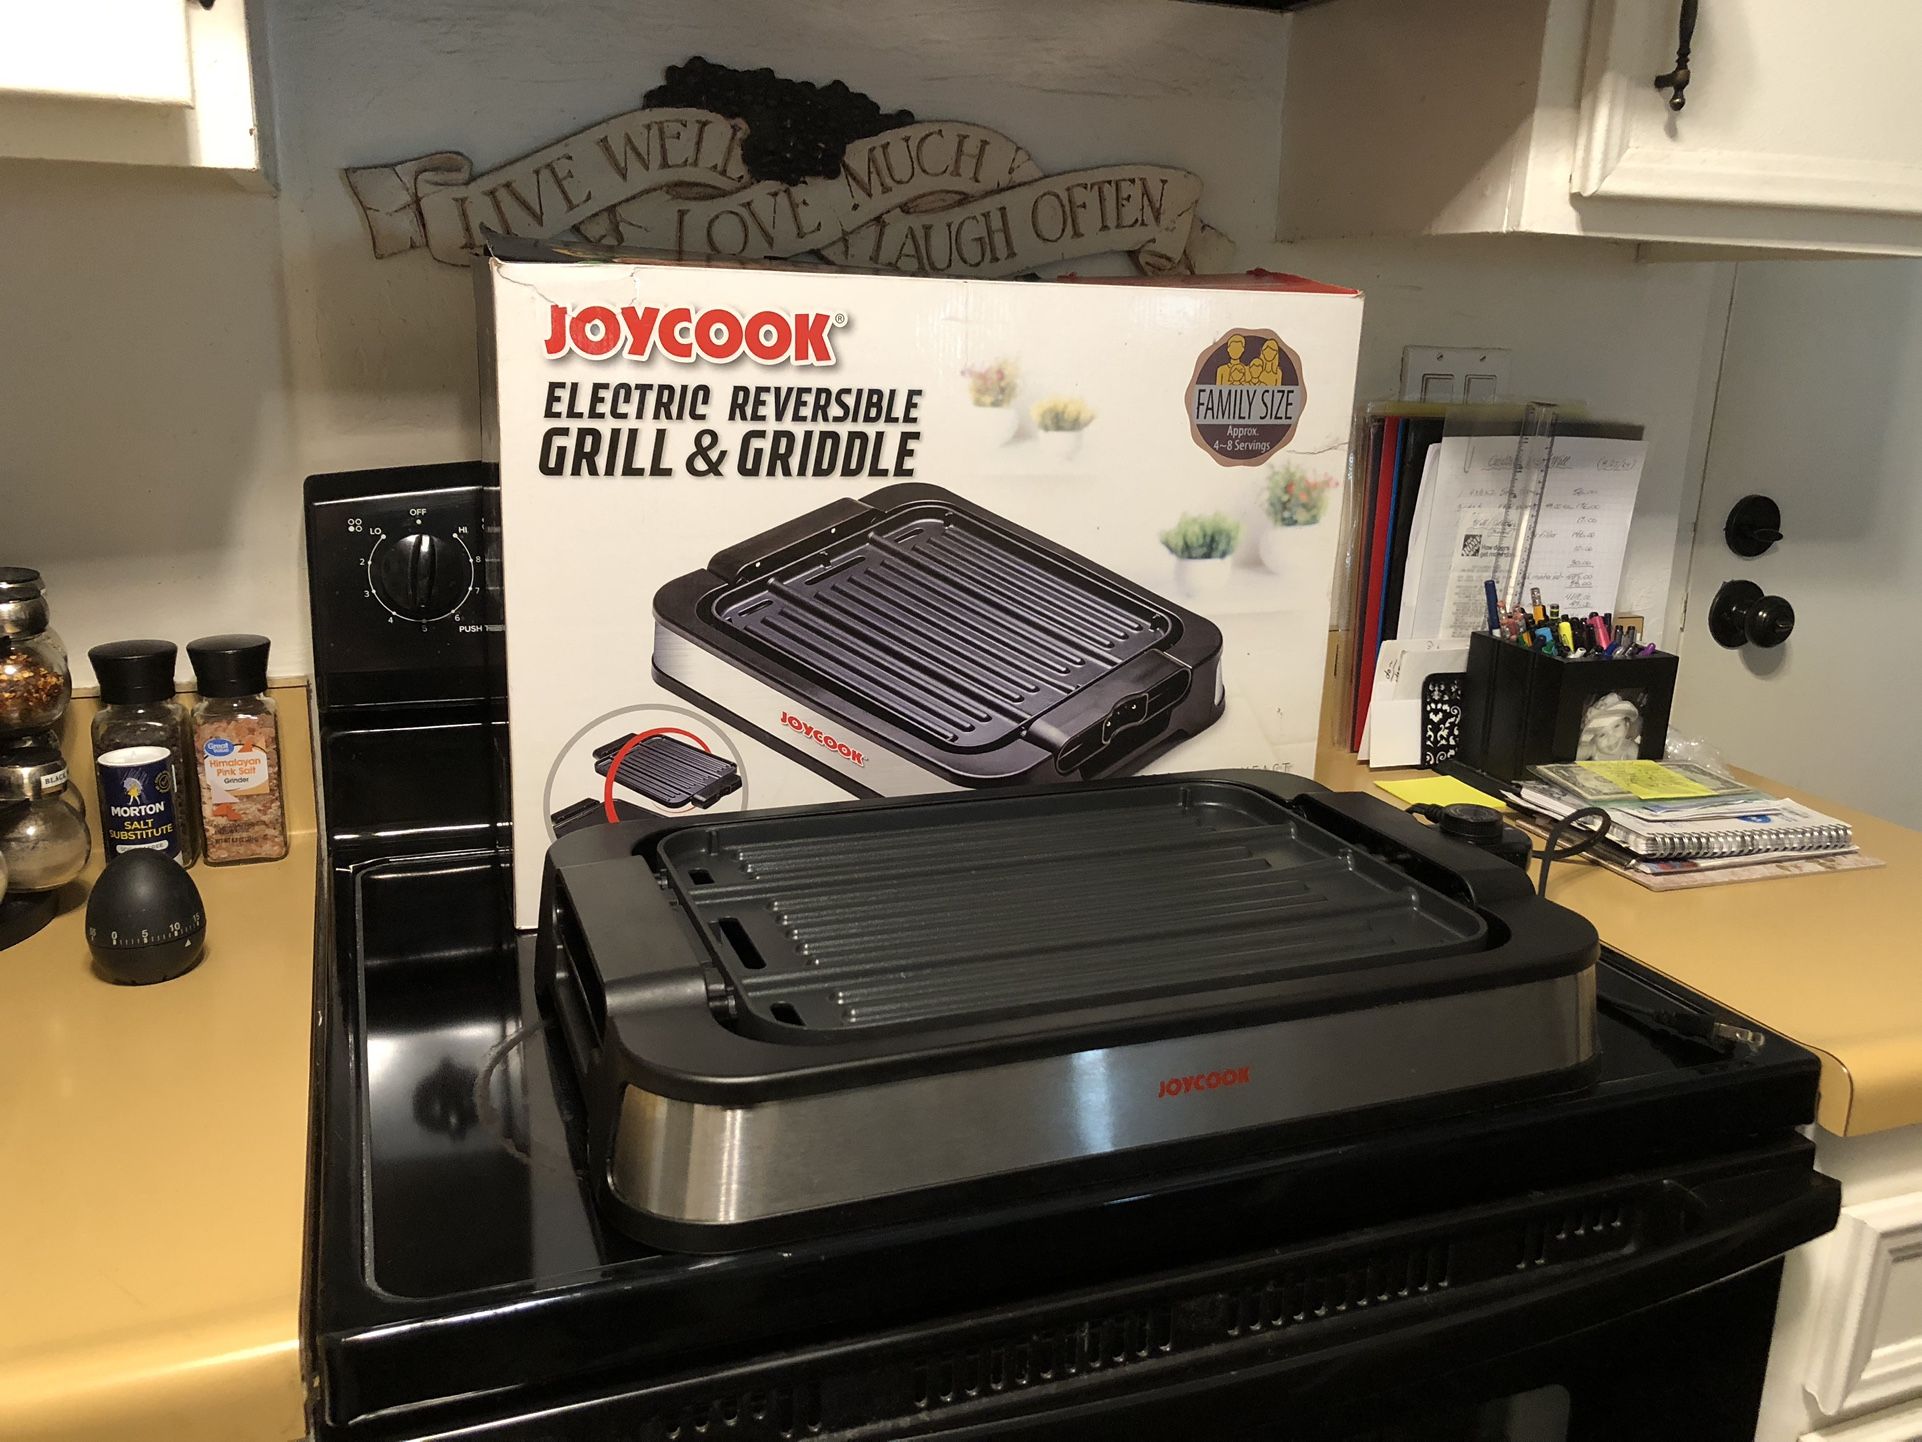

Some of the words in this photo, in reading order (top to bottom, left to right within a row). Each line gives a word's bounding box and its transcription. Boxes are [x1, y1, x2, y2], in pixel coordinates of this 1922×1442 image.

[598, 119, 745, 183] WELL
[840, 129, 991, 199] MUCH
[869, 207, 1017, 273] LAUGH
[1031, 177, 1168, 243] OFTEN
[543, 381, 711, 421] ELECTRIC
[727, 385, 923, 424] REVERSIBLE
[1196, 389, 1258, 420] FAMILY
[1259, 389, 1295, 420] SIZE
[1226, 425, 1260, 438] Approx.
[538, 426, 674, 478] GRILL
[685, 428, 728, 478] &
[737, 429, 922, 479] GRIDDLE
[1234, 439, 1271, 453] Servings
[409, 508, 427, 516] OFF
[369, 527, 382, 535] LO
[359, 558, 365, 566] 2
[364, 590, 370, 598] 3
[387, 616, 394, 624] 4
[454, 614, 460, 622] 6
[209, 757, 261, 769] Himalayan
[216, 767, 237, 776] Pink
[238, 766, 256, 775] Salt
[110, 801, 165, 817] MORTON
[109, 823, 174, 840] SUBSTITUTE
[124, 819, 154, 830] SALT
[111, 931, 118, 940] 0
[141, 929, 149, 938] 5
[169, 922, 181, 932] 10
[1158, 1066, 1250, 1098] JOYCOOK
